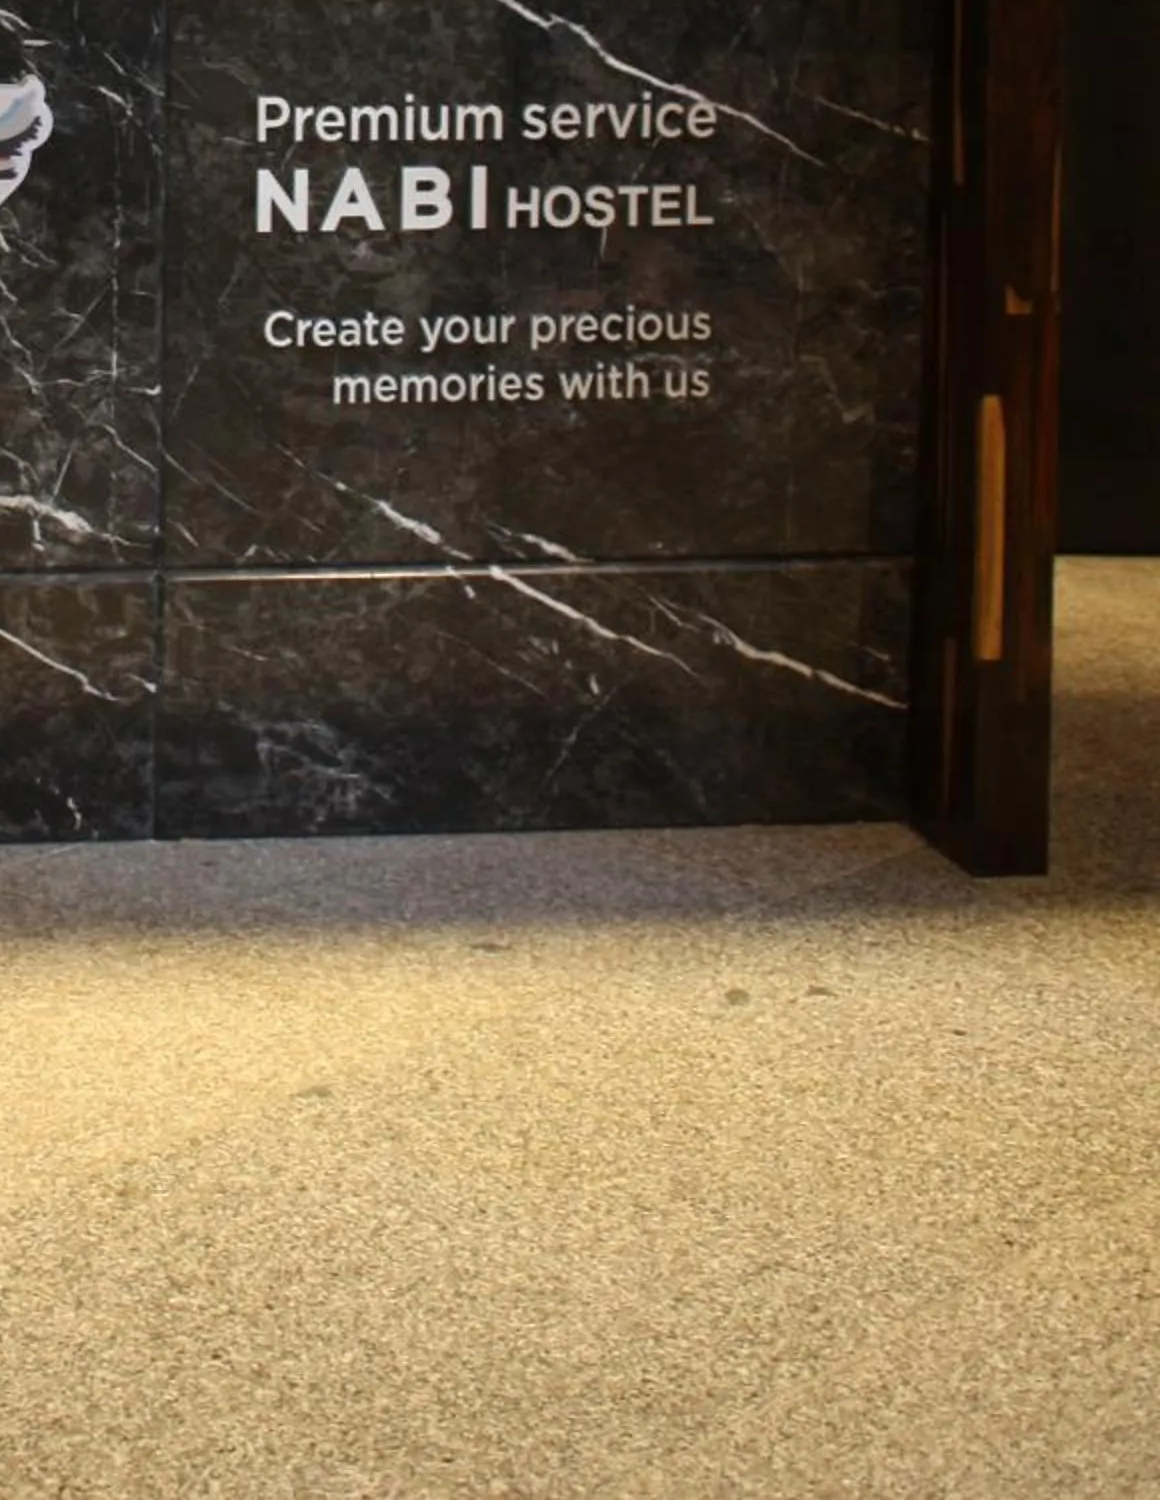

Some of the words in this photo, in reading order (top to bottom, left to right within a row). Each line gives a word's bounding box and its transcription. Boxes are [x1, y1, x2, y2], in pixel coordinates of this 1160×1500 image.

[257, 94, 503, 142] Premium
[522, 91, 717, 140] service
[256, 165, 488, 233] NABI
[507, 185, 714, 229] HOSTEL
[264, 311, 405, 347] Create
[420, 315, 515, 352] your
[531, 305, 711, 350] precious
[333, 366, 544, 404] memories
[560, 363, 649, 399] with
[665, 369, 710, 398] us
